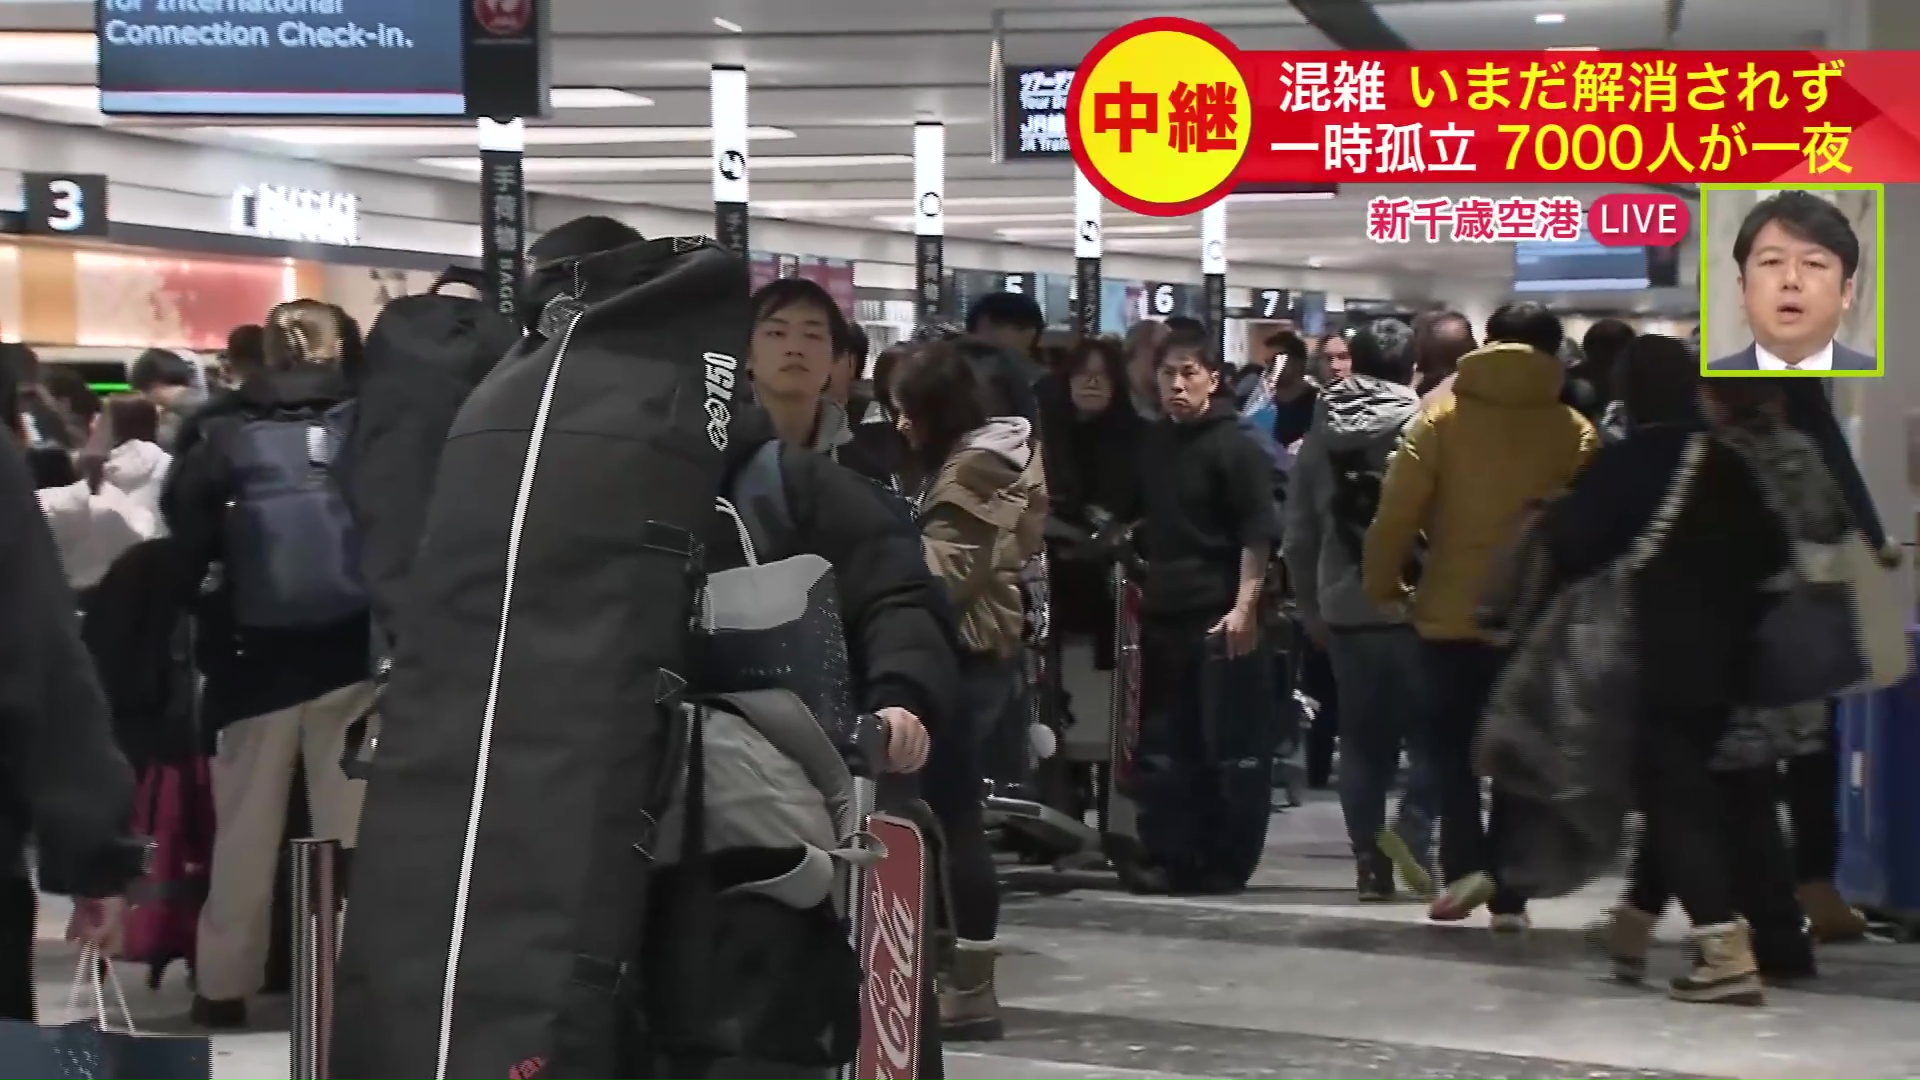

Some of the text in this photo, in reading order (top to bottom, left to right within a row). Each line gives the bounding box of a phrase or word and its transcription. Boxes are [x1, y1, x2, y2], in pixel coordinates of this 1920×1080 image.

[105, 19, 269, 46] Connection
[47, 179, 84, 231] 3
[1153, 285, 1175, 314] 6
[1261, 289, 1280, 318] 7
